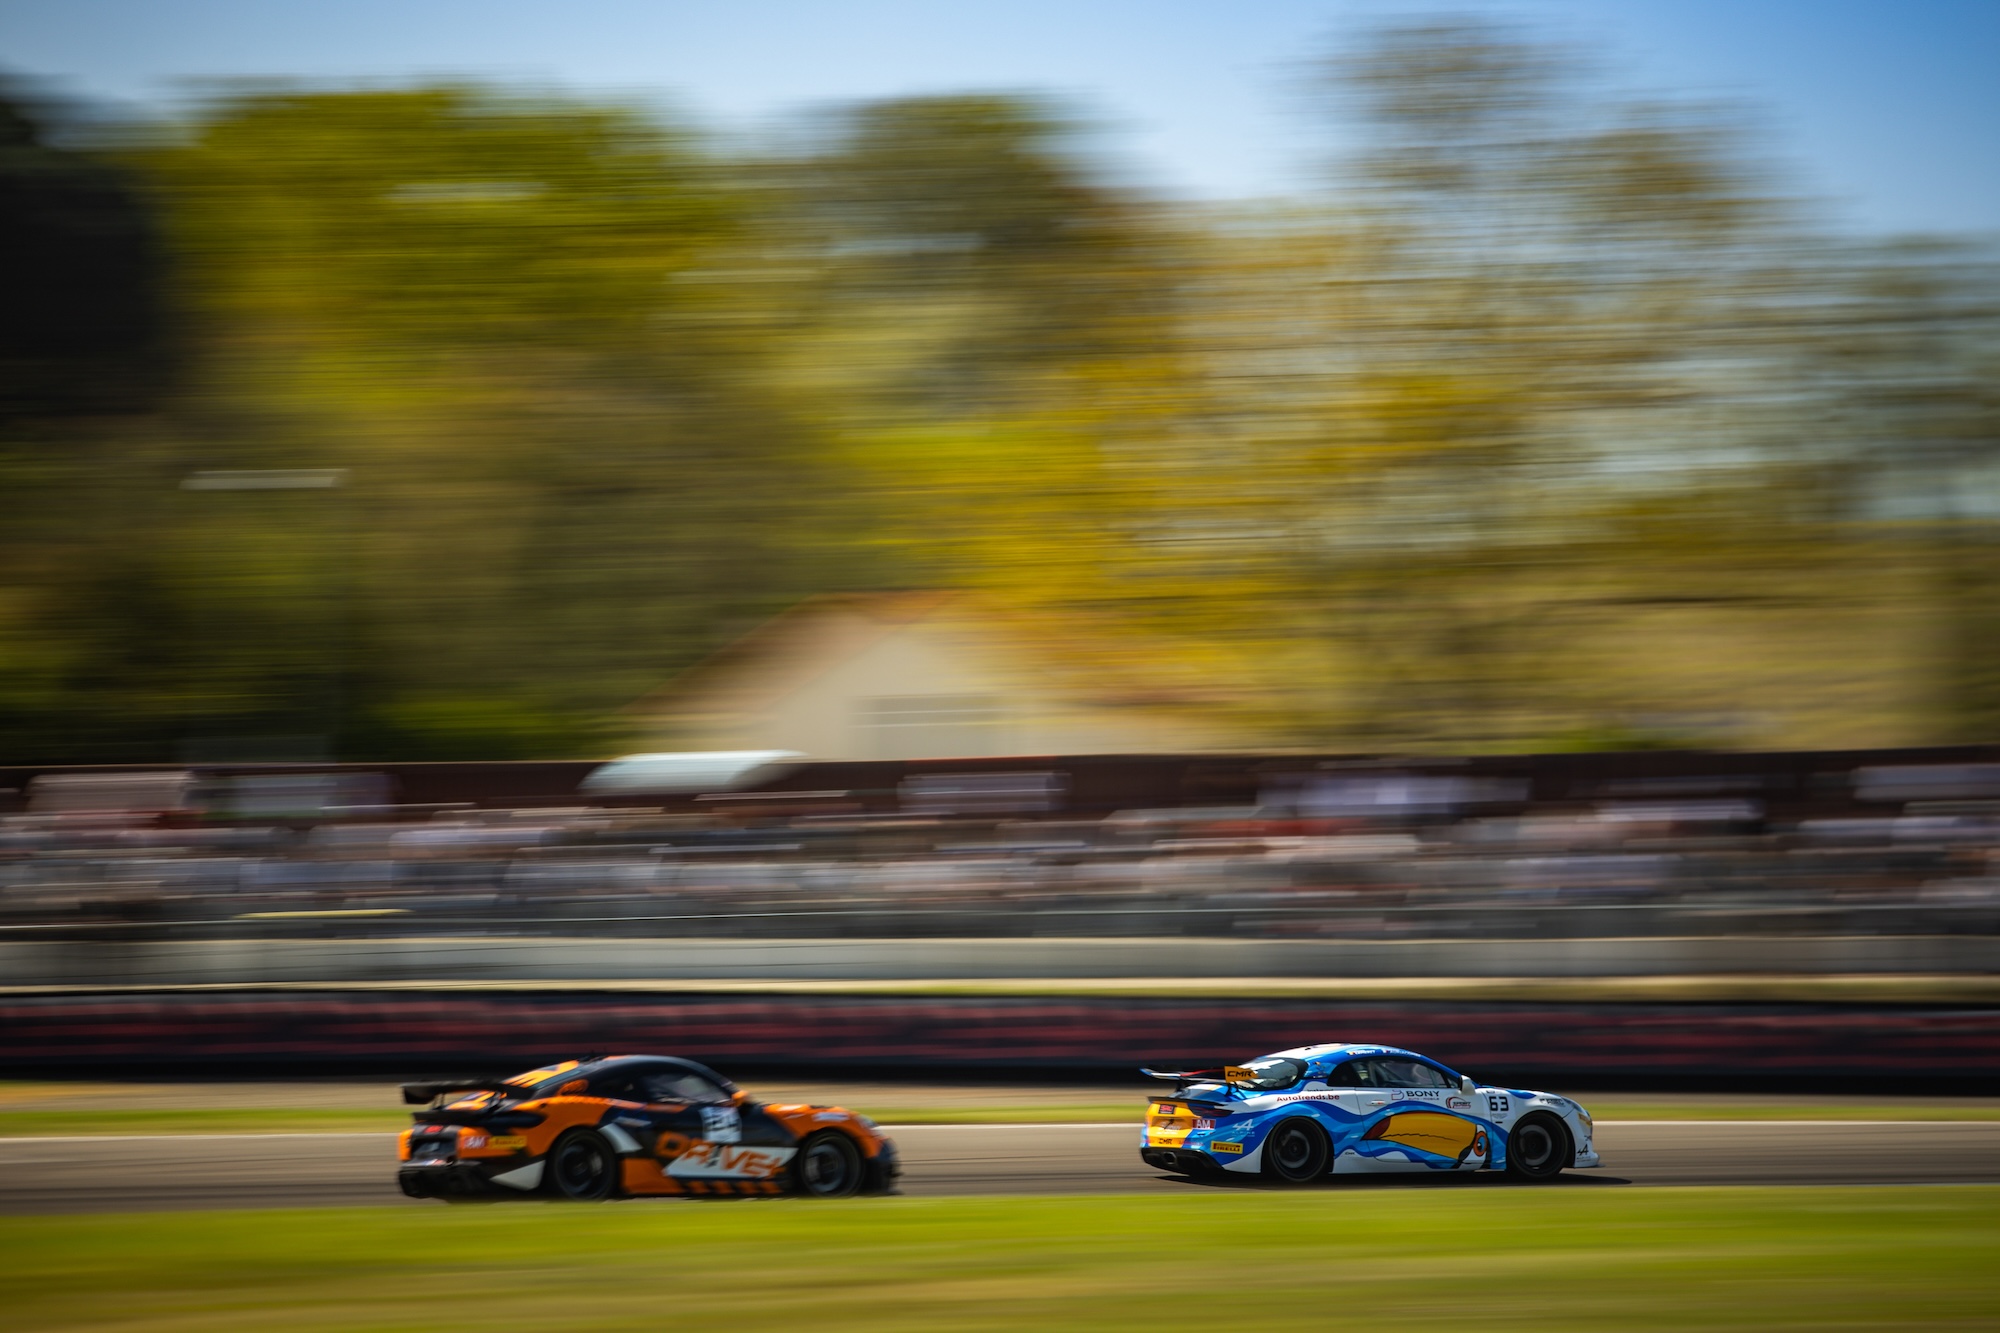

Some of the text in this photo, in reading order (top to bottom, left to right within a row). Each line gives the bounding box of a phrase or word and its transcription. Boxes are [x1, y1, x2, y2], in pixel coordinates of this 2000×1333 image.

[1489, 1096, 1509, 1111] 63
[1196, 1120, 1211, 1129] AM
[1213, 1143, 1241, 1152] PIRELLI
